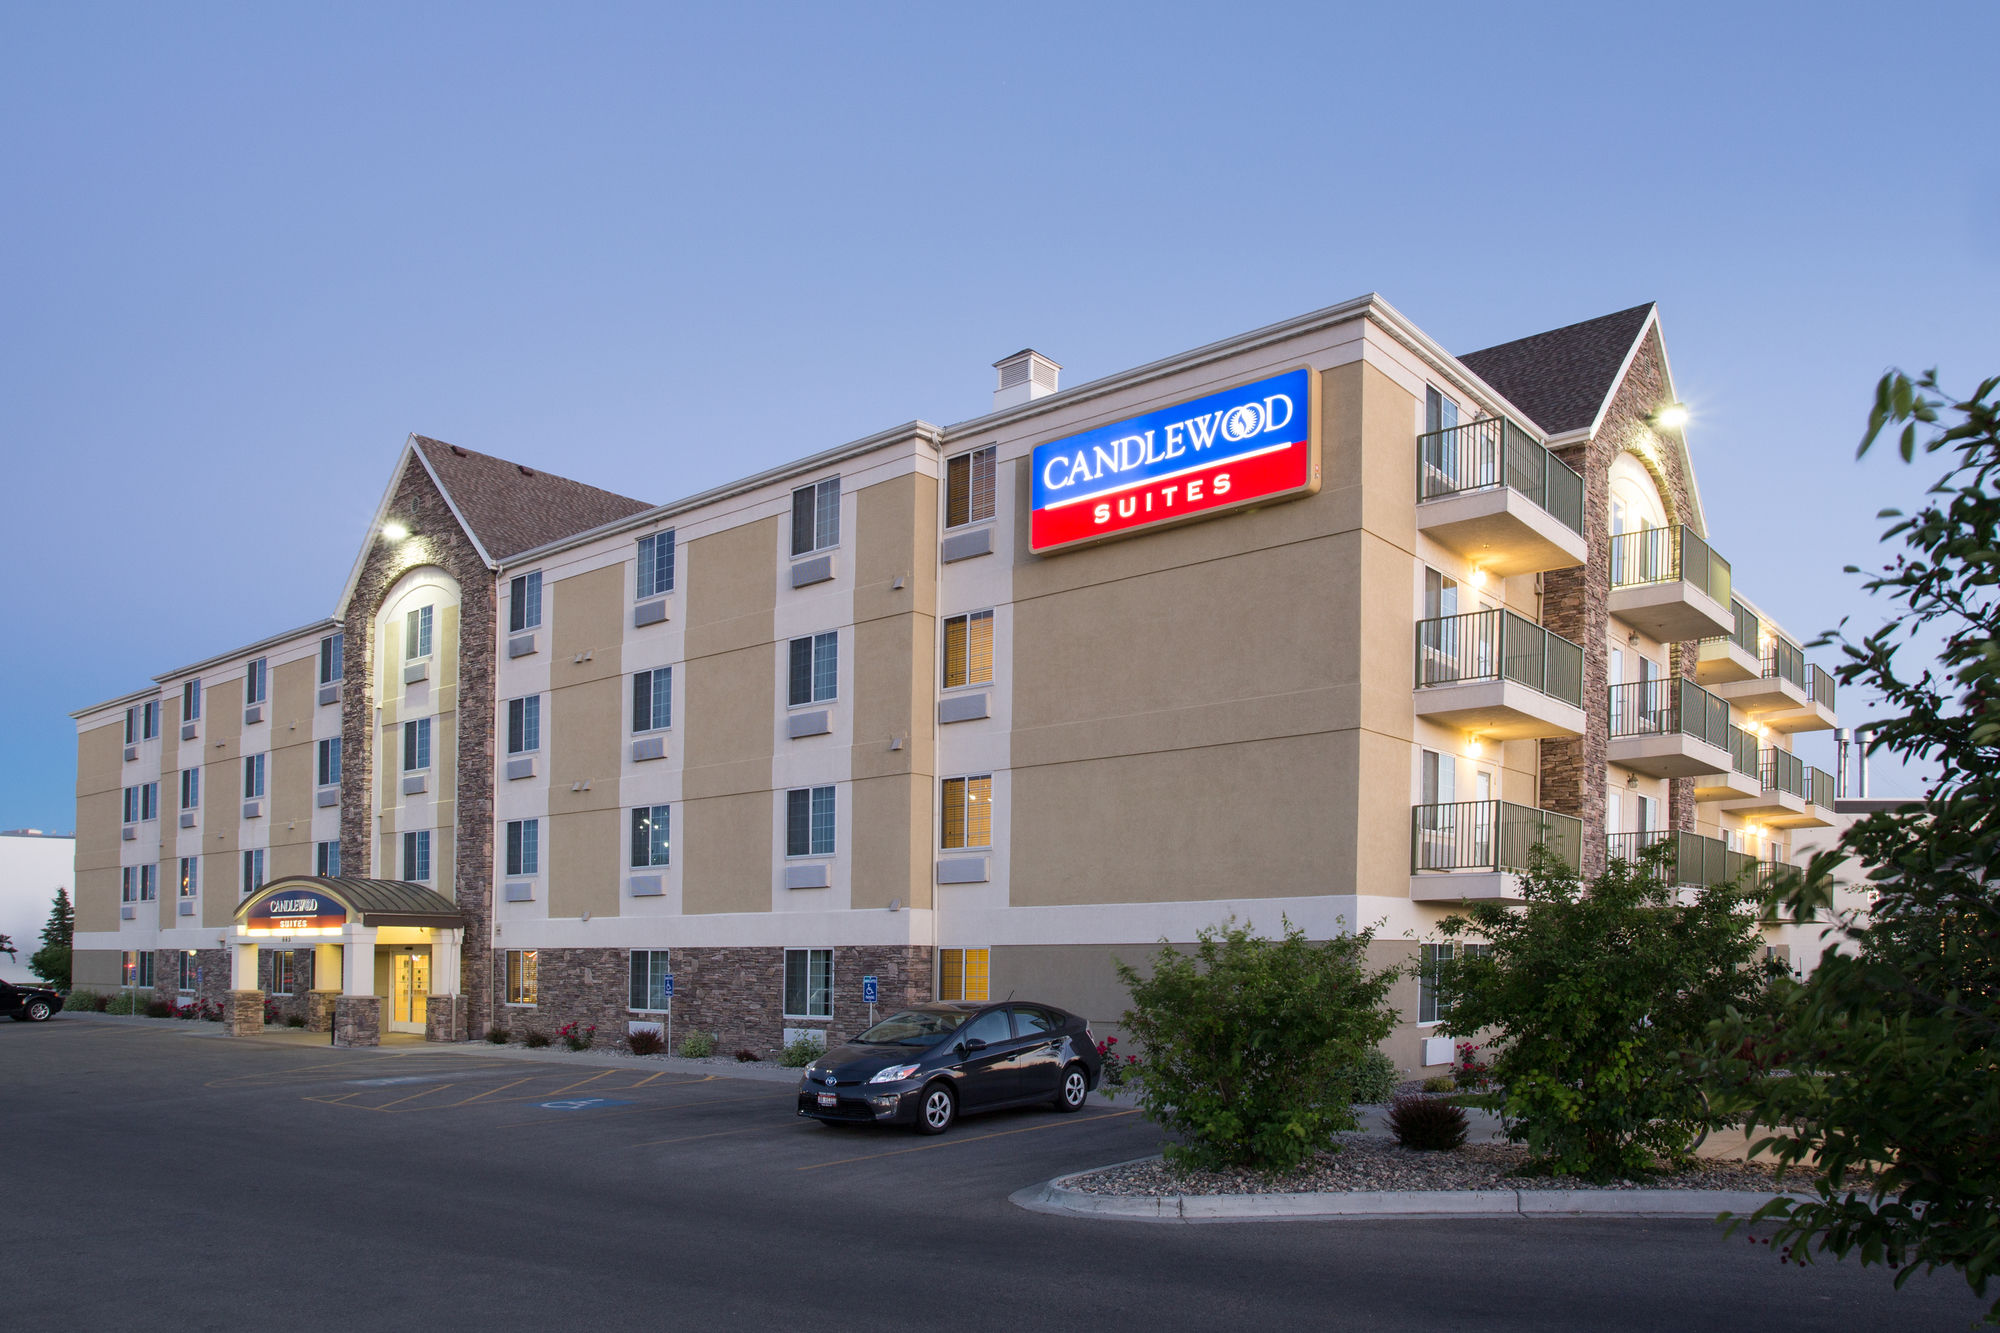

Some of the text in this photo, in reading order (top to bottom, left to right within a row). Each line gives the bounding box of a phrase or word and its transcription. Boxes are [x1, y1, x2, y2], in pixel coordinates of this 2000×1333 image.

[1043, 394, 1293, 490] CANDLEWOOD
[1094, 473, 1232, 524] SUITES
[270, 899, 318, 912] CANDLEWOOD
[280, 920, 307, 928] SUITES
